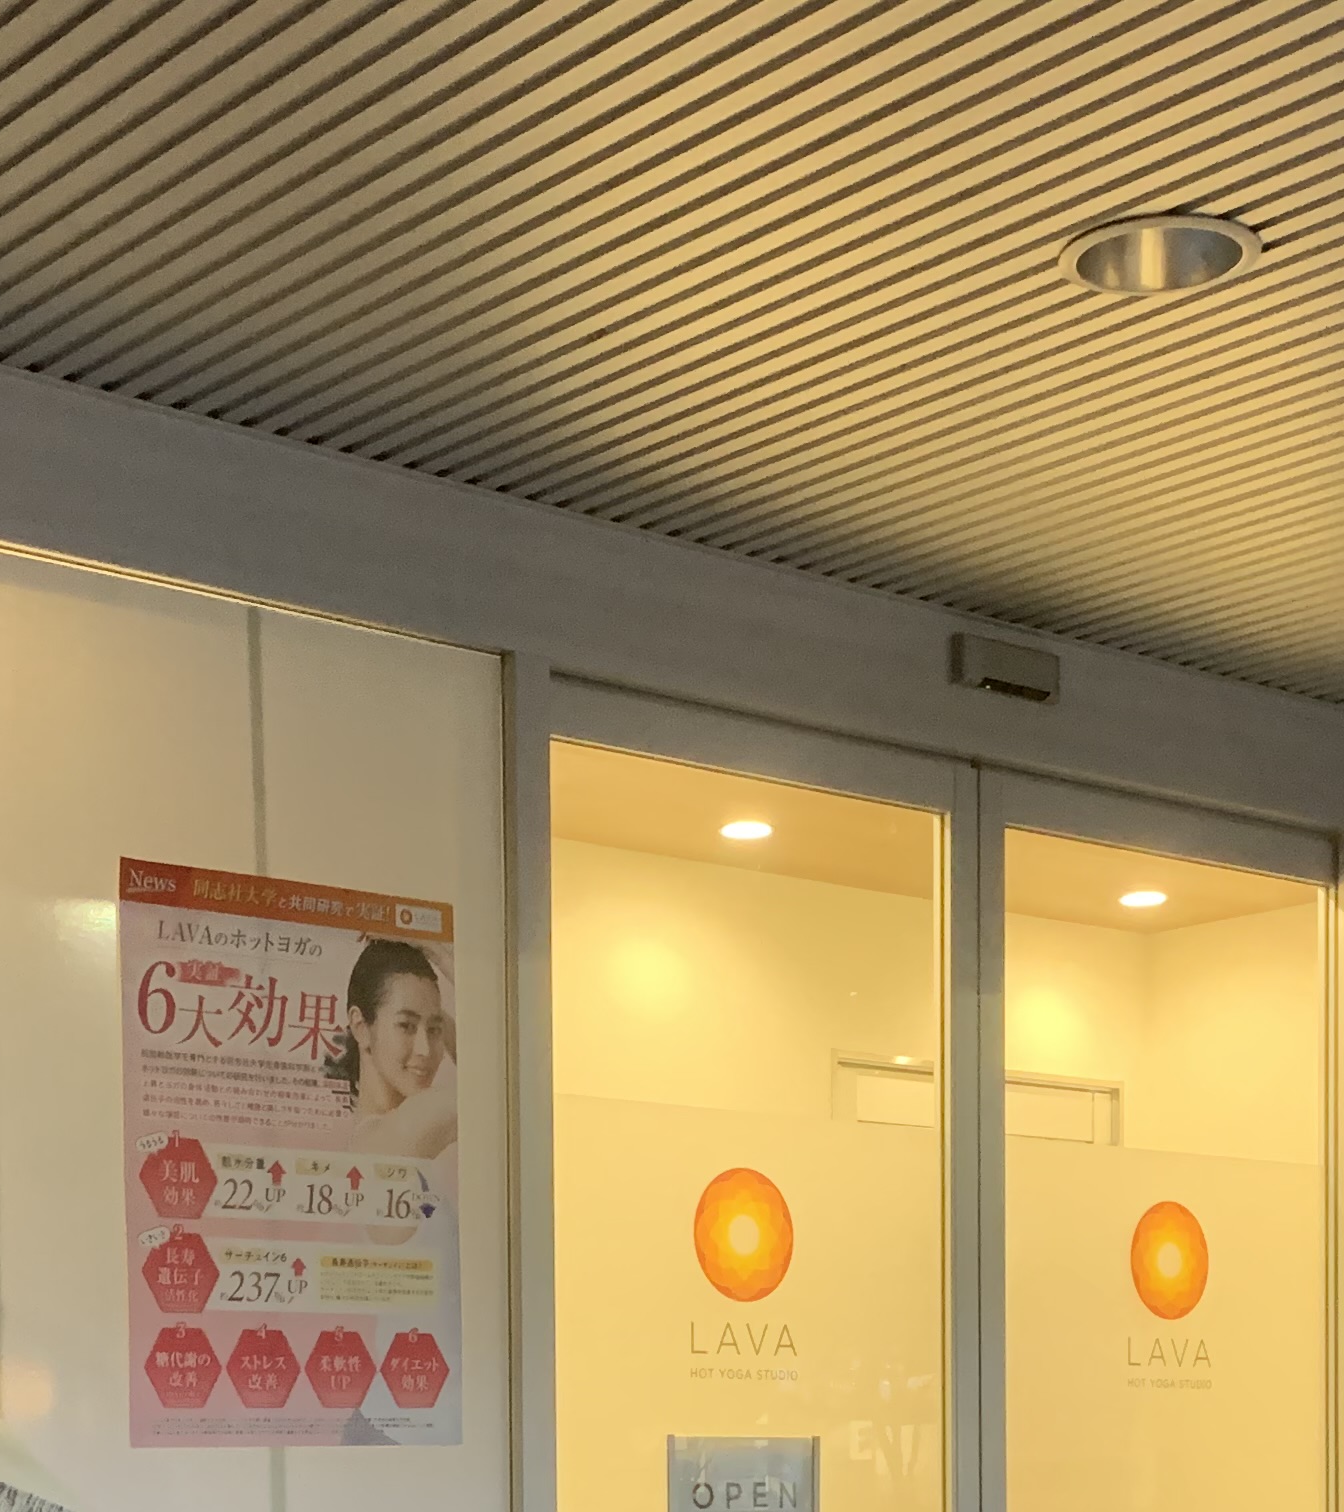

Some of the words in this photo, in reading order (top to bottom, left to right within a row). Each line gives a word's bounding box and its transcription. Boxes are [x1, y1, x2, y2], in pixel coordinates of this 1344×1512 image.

[128, 868, 177, 892] News
[158, 920, 323, 956] LAVAのホットヨガの
[160, 1160, 200, 1184] 美肌
[163, 1186, 196, 1206] 効果
[265, 1187, 287, 1203] UP
[344, 1192, 365, 1207] UP
[172, 1223, 184, 1240] 2
[166, 1248, 196, 1266] 長寿
[157, 1266, 204, 1286] 遺伝子
[287, 1279, 309, 1294] UP
[690, 1320, 798, 1357] LAVA
[1127, 1336, 1212, 1368] LAVA
[240, 1354, 287, 1370] ストレス
[390, 1357, 439, 1372] ダイエット
[400, 1374, 429, 1392] 効果
[690, 1367, 714, 1380] HOT
[718, 1368, 752, 1381] YOGA
[756, 1369, 799, 1382] STUDIO
[1127, 1377, 1146, 1388] HOT
[1149, 1378, 1176, 1389] YOGA
[1179, 1379, 1213, 1390] STUDIO
[692, 1481, 798, 1510] OPEN
